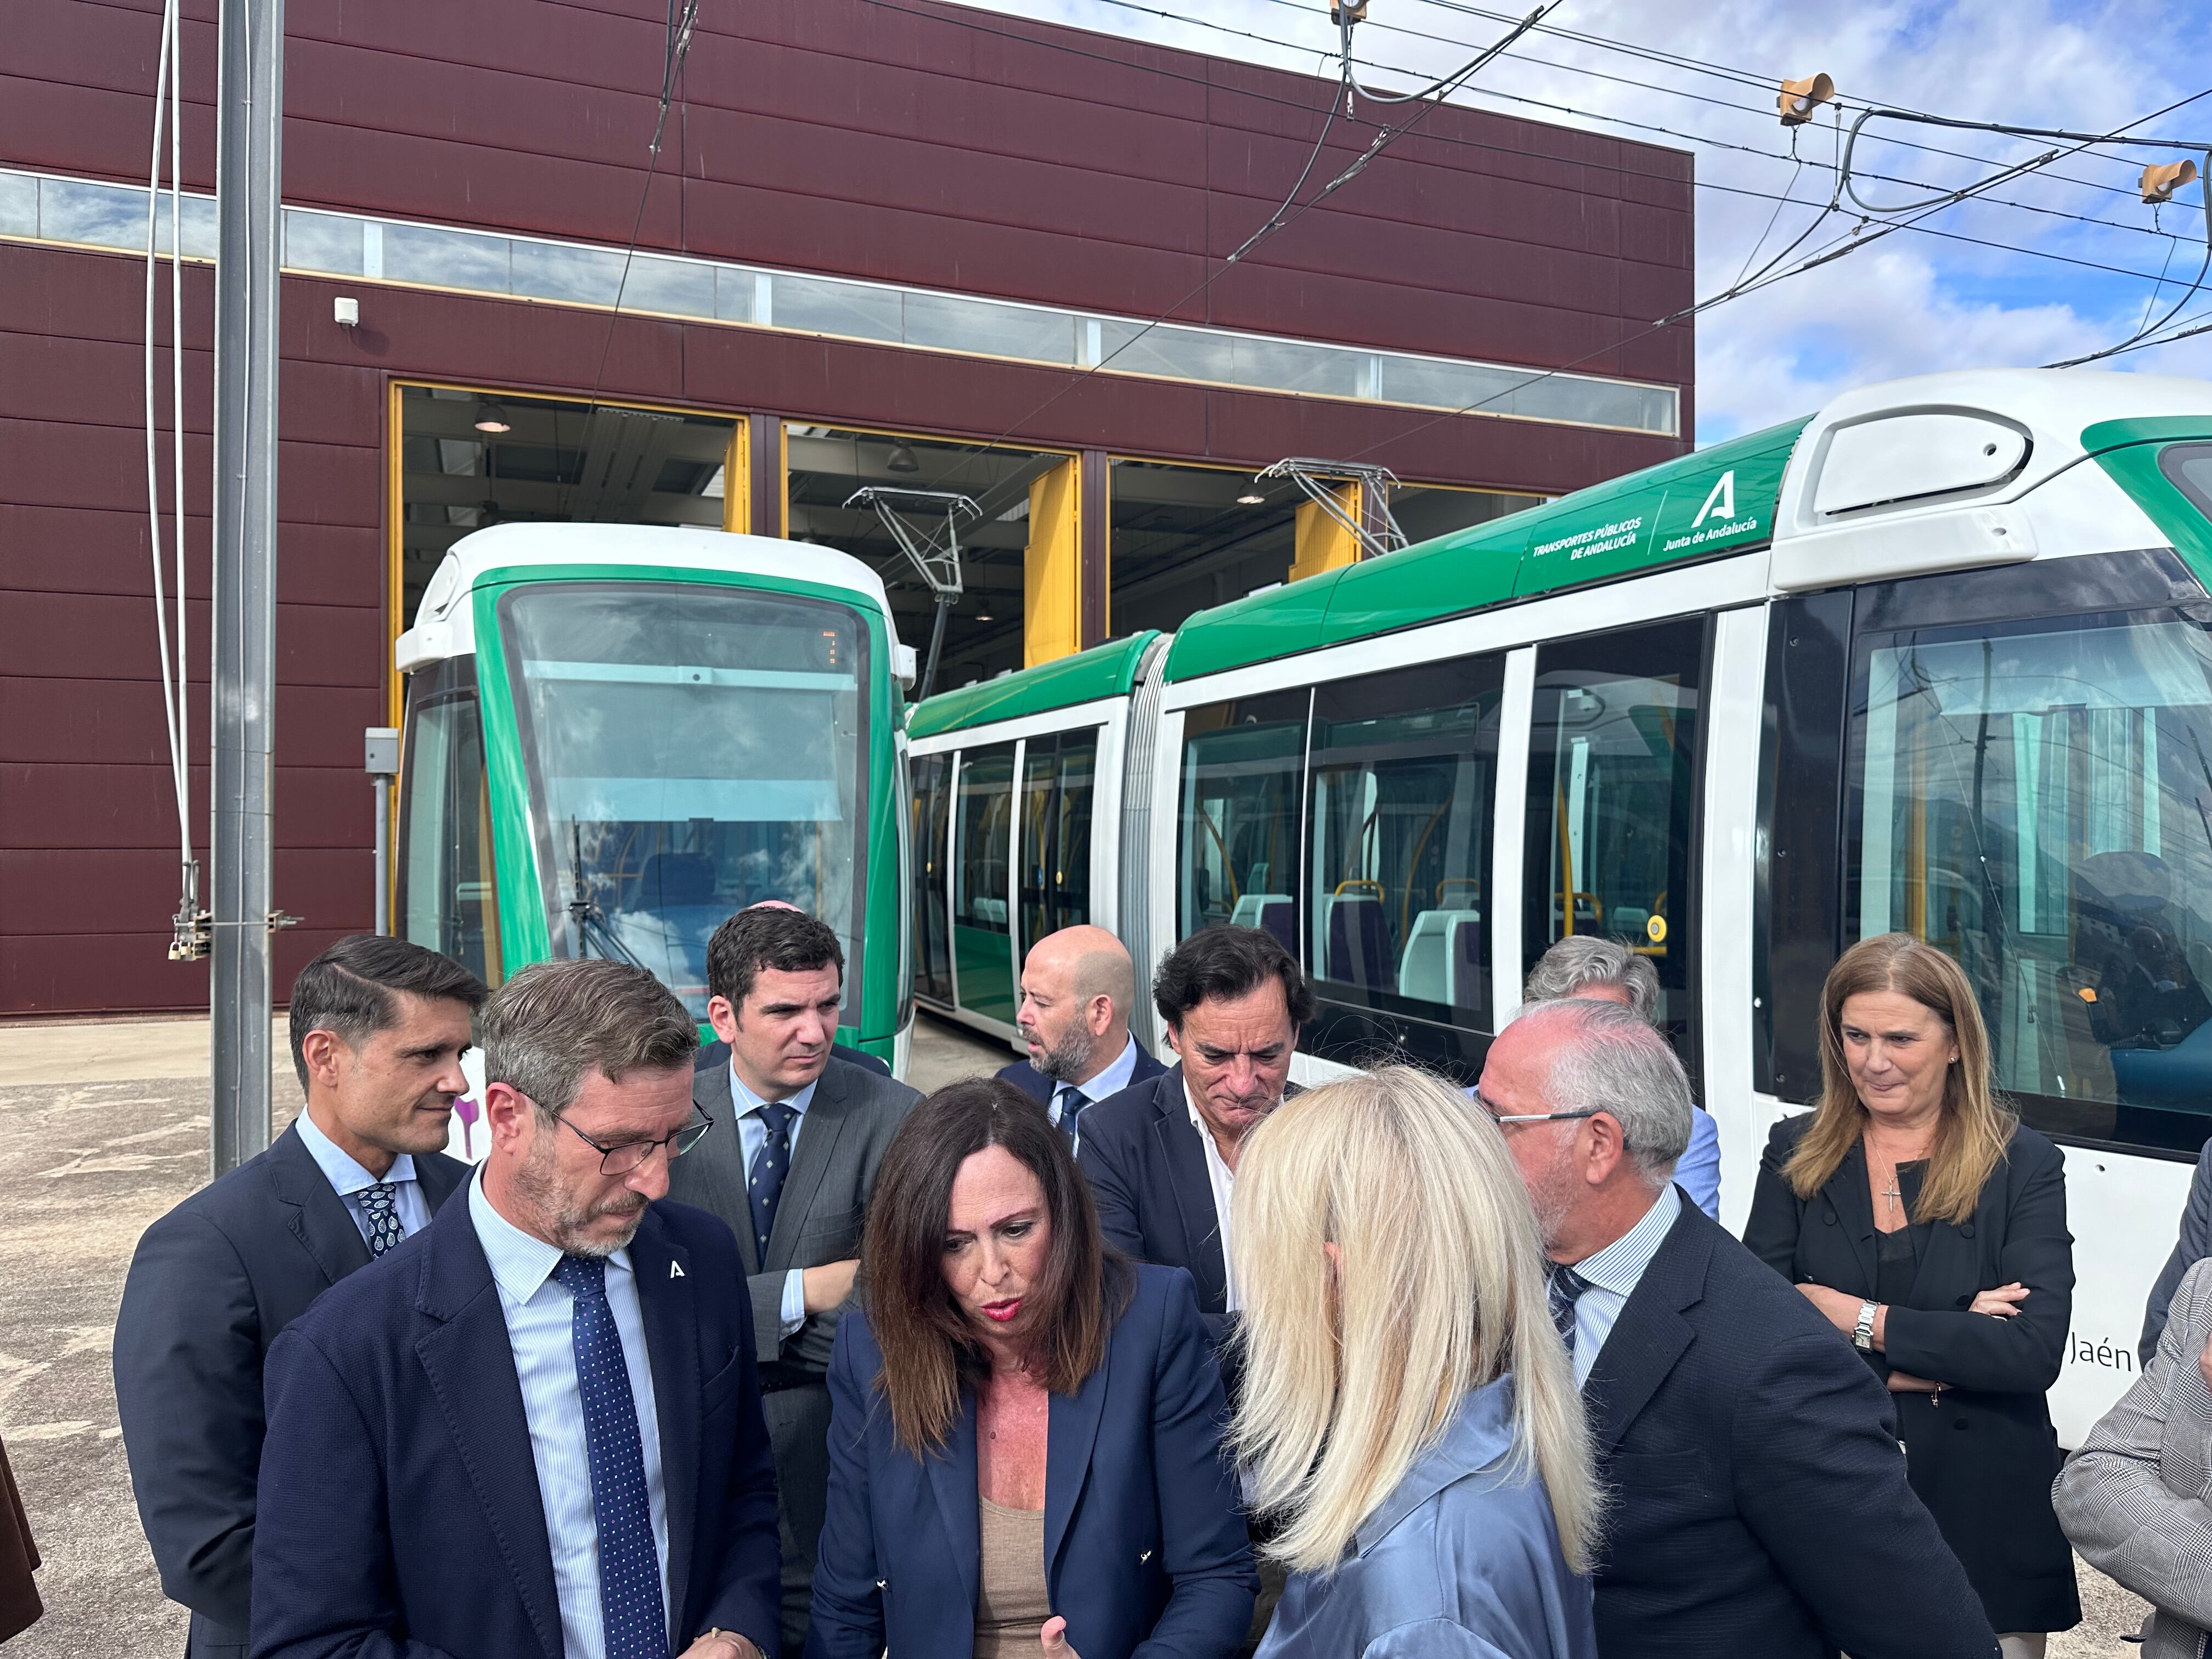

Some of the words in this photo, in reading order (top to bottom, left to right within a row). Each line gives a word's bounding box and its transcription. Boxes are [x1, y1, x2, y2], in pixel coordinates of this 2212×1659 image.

[1533, 531, 1594, 557] TRANSPORTES
[1594, 516, 1643, 540] PÚBLICOS
[1570, 546, 1584, 561] DE
[1583, 531, 1636, 557] ANDALUCÍA
[1663, 536, 1691, 552] Junta
[1692, 531, 1705, 544] de
[1706, 516, 1757, 541] Andalucía
[2070, 1331, 2131, 1372] Jaén
